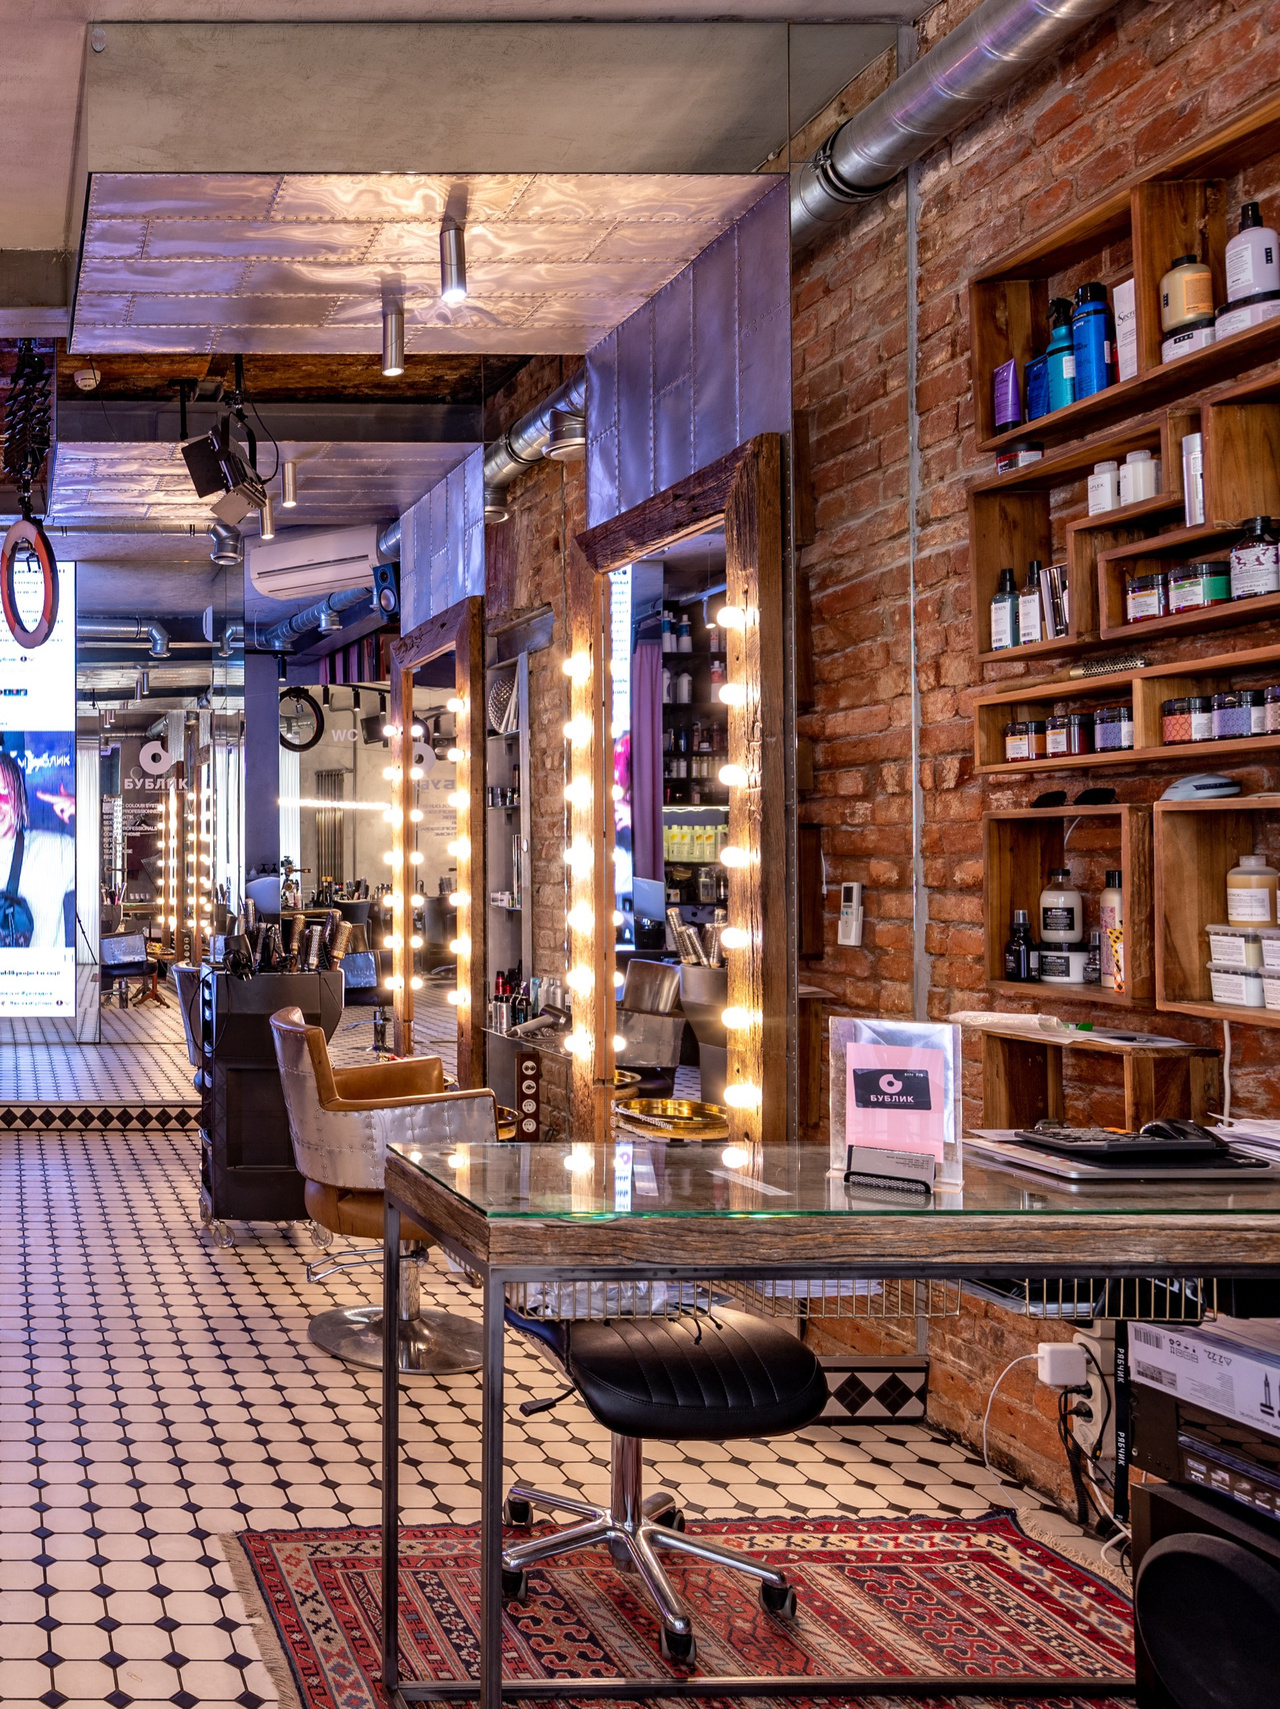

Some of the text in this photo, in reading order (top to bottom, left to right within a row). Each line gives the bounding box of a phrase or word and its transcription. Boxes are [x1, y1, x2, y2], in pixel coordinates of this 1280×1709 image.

[331, 728, 360, 742] WC
[124, 778, 188, 789] БУБЛИК
[870, 1094, 914, 1103] БУБЛИК
[1117, 1347, 1125, 1384] РЯБЧИК
[1118, 1431, 1126, 1467] РЯБЧИК
